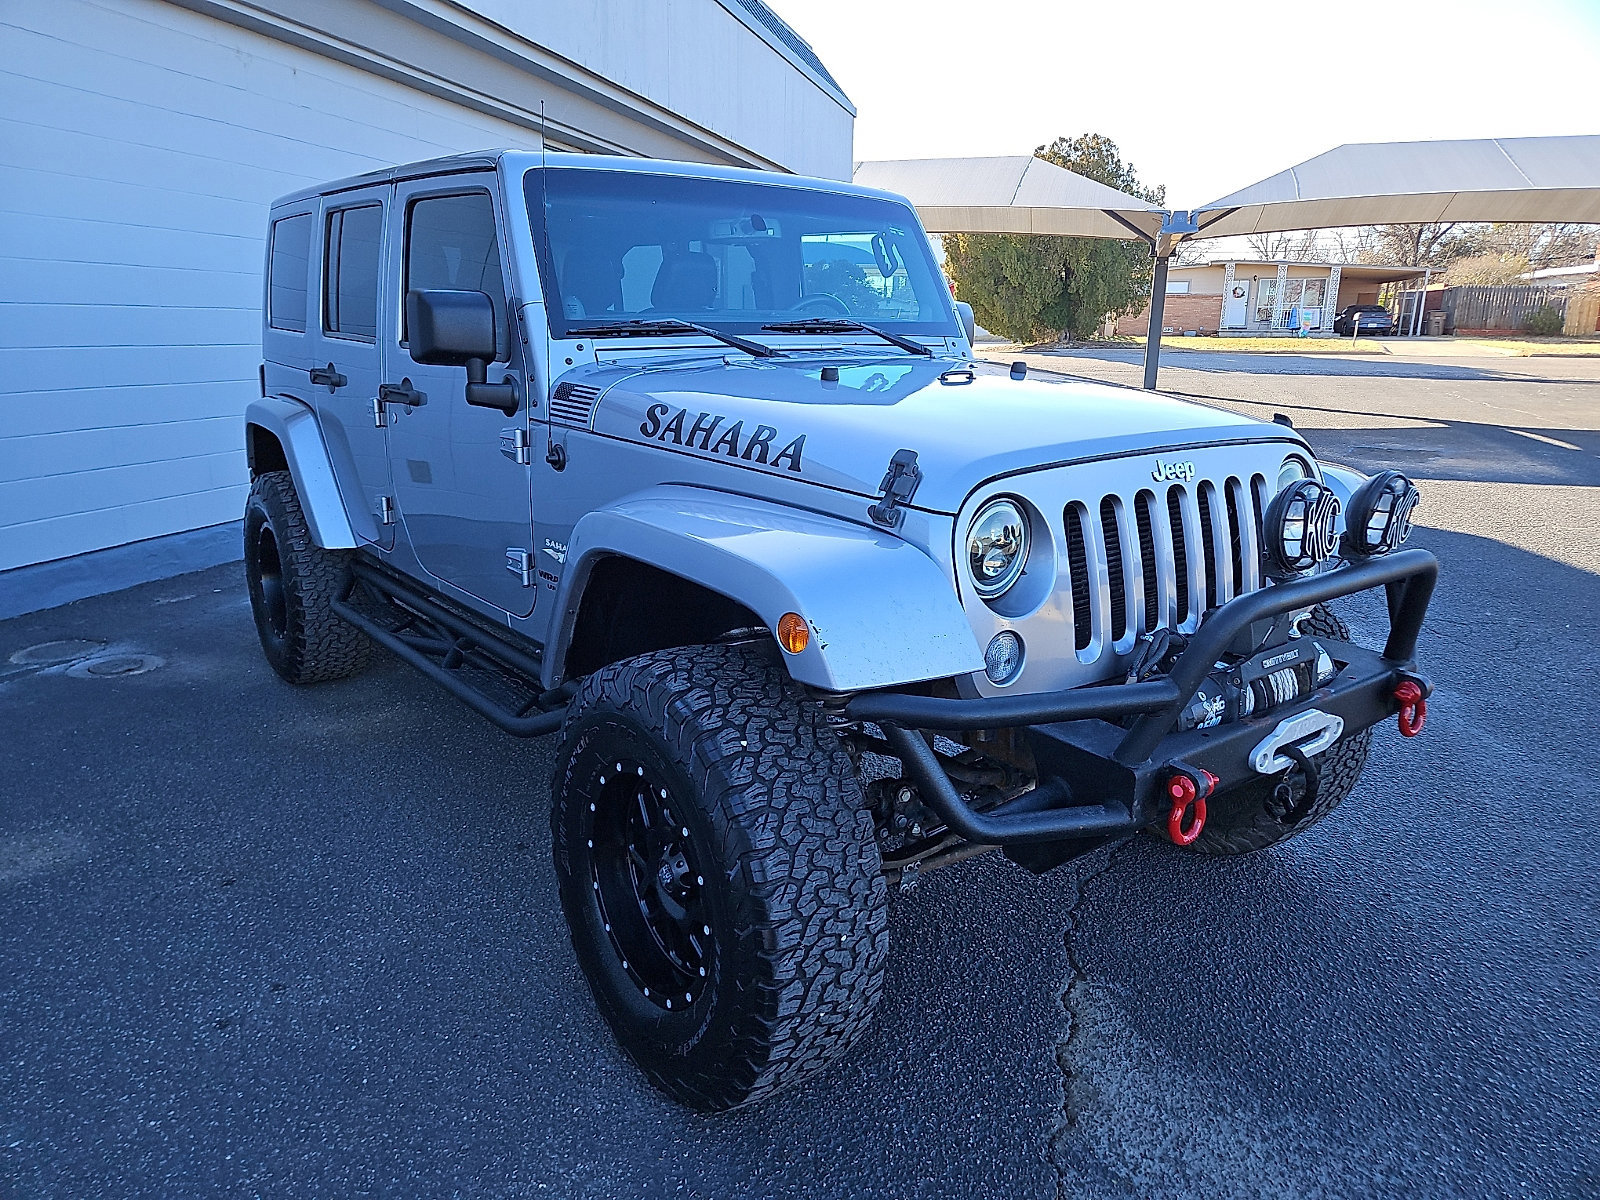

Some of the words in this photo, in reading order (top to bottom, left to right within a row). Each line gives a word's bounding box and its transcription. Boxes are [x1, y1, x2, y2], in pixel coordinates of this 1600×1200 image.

[639, 403, 806, 472] SAHARA
[1151, 459, 1195, 482] Jeep
[1306, 491, 1341, 562] KC
[1386, 487, 1420, 550] KC
